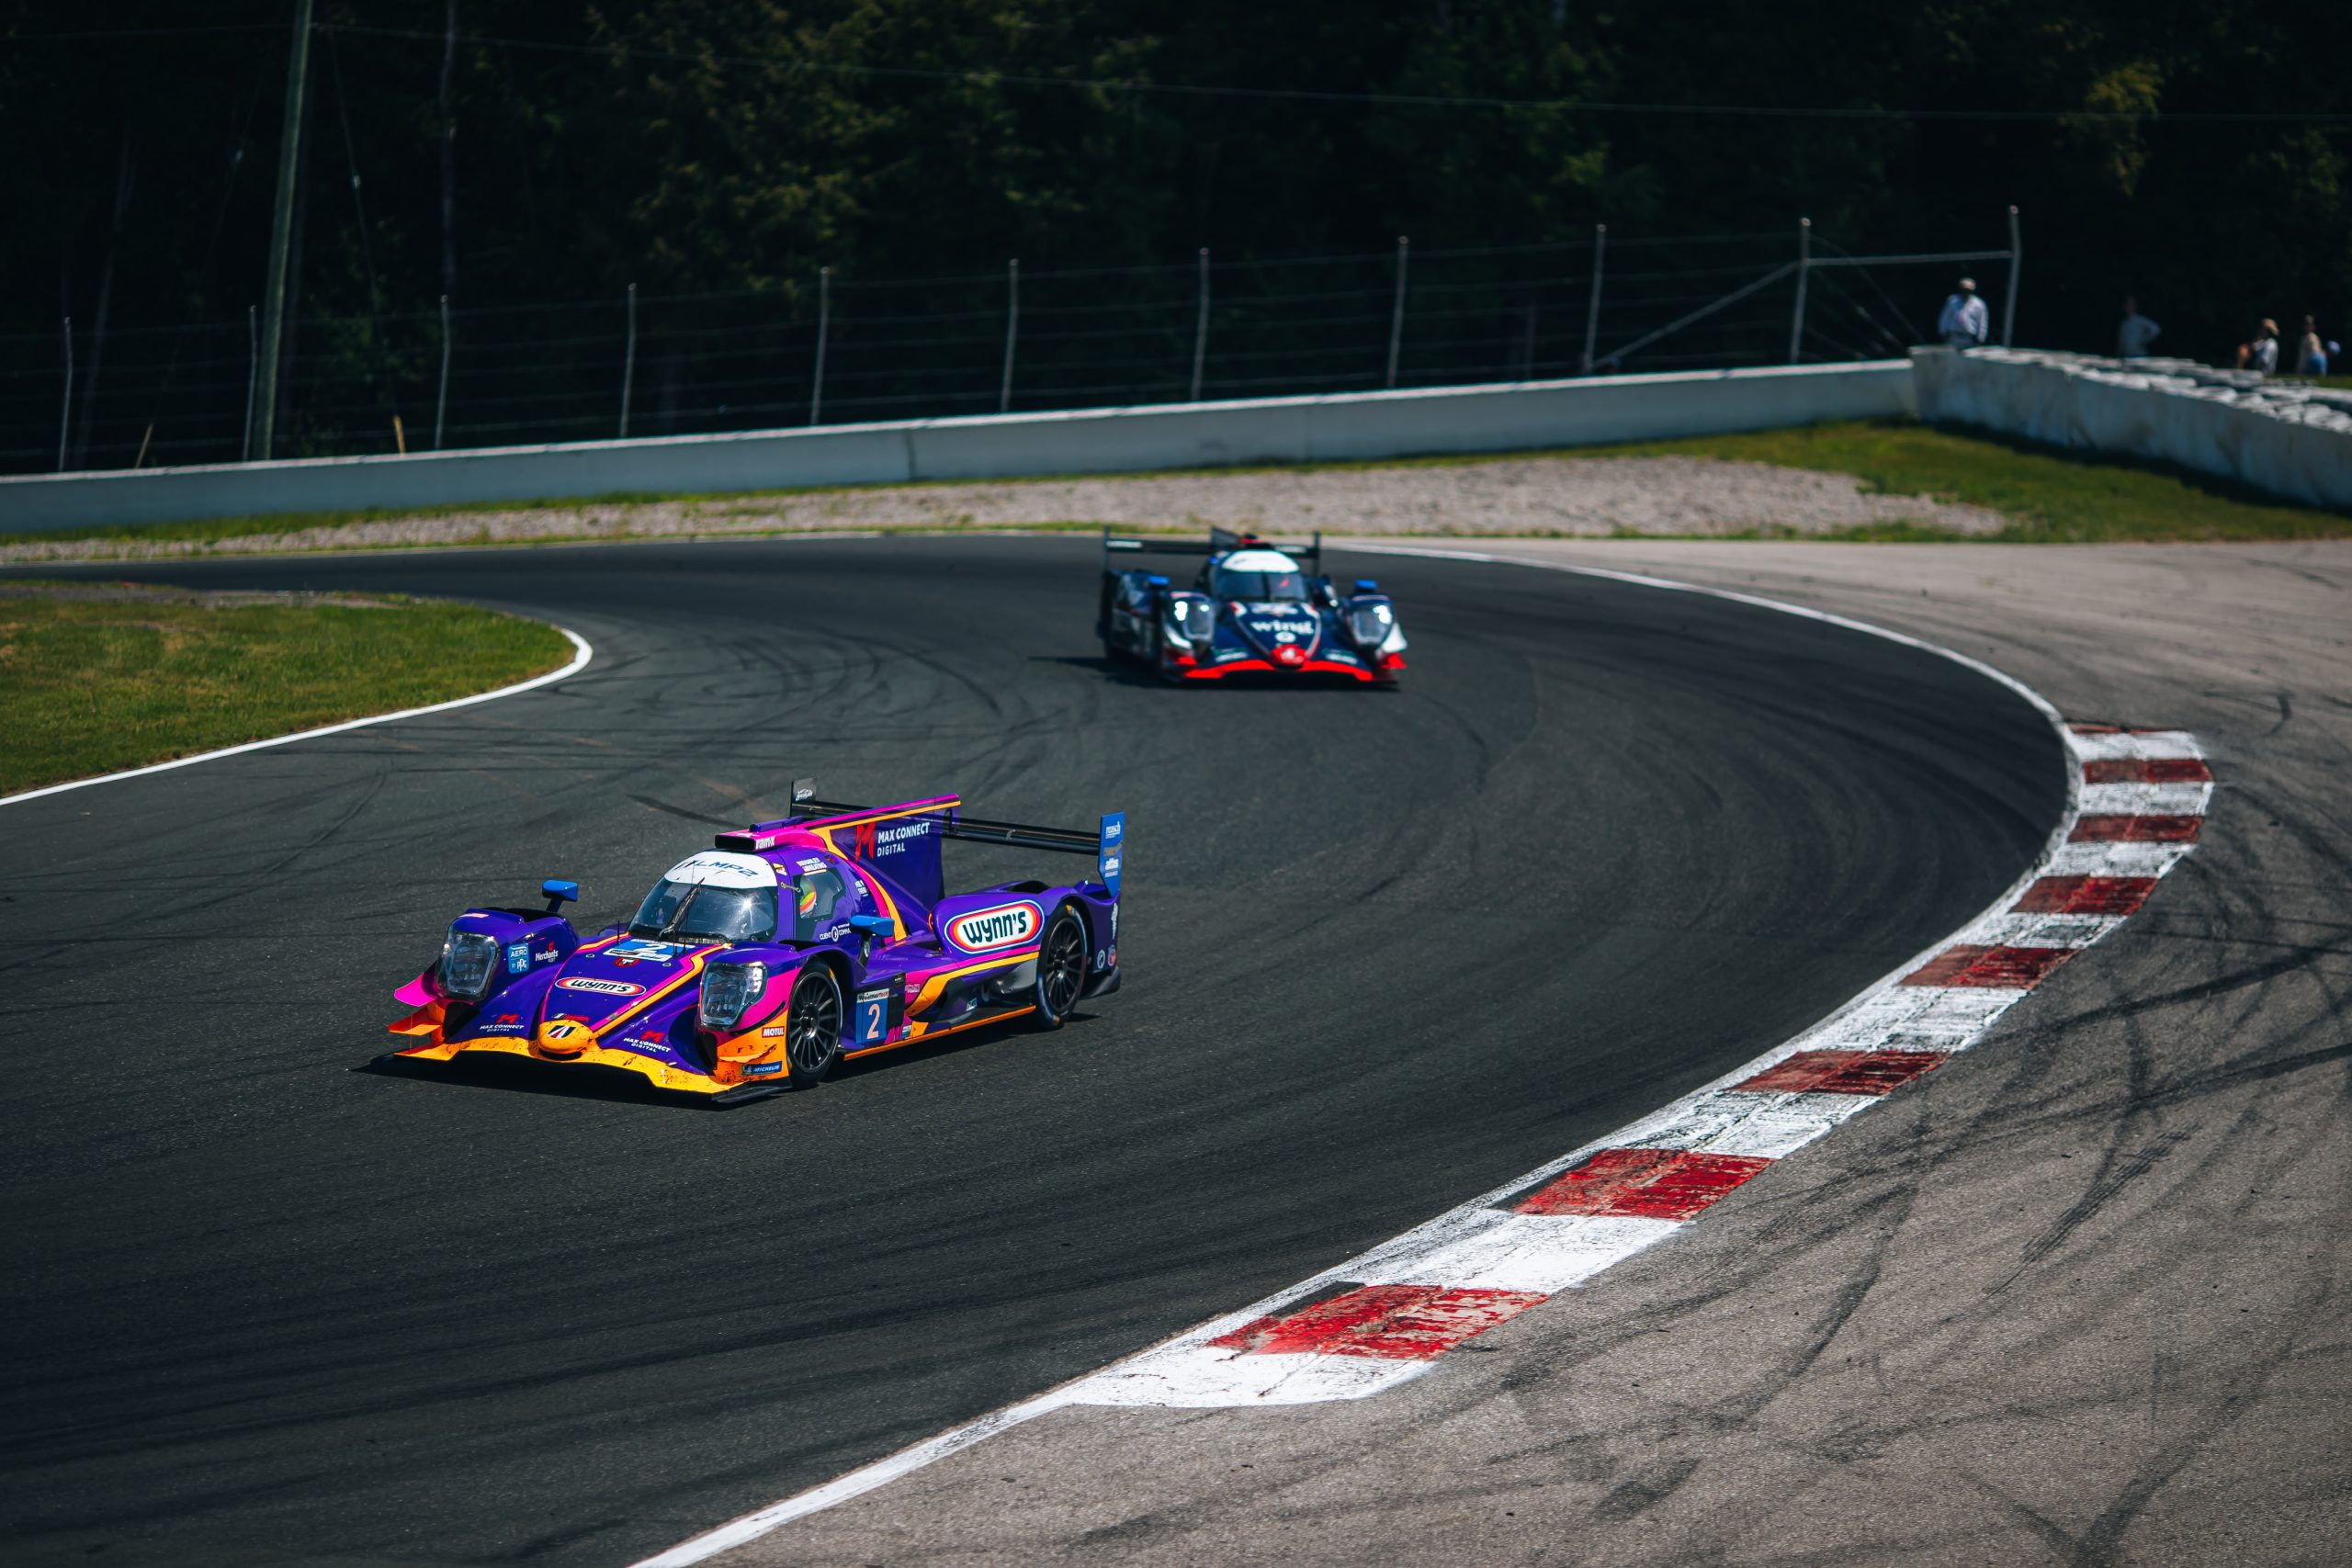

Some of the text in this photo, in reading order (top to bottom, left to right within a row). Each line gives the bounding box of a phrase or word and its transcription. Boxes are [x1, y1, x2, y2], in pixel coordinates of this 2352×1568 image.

[877, 821, 930, 844] MAX CONNECT
[876, 842, 906, 857] DIGITAL
[510, 949, 527, 958] AERO
[634, 943, 667, 953] 2
[535, 949, 559, 962] Merchants
[866, 1003, 881, 1040] 2
[763, 1027, 784, 1037] MOTUL
[631, 1043, 657, 1053] DIGITAL
[639, 1039, 671, 1053] CONNECT
